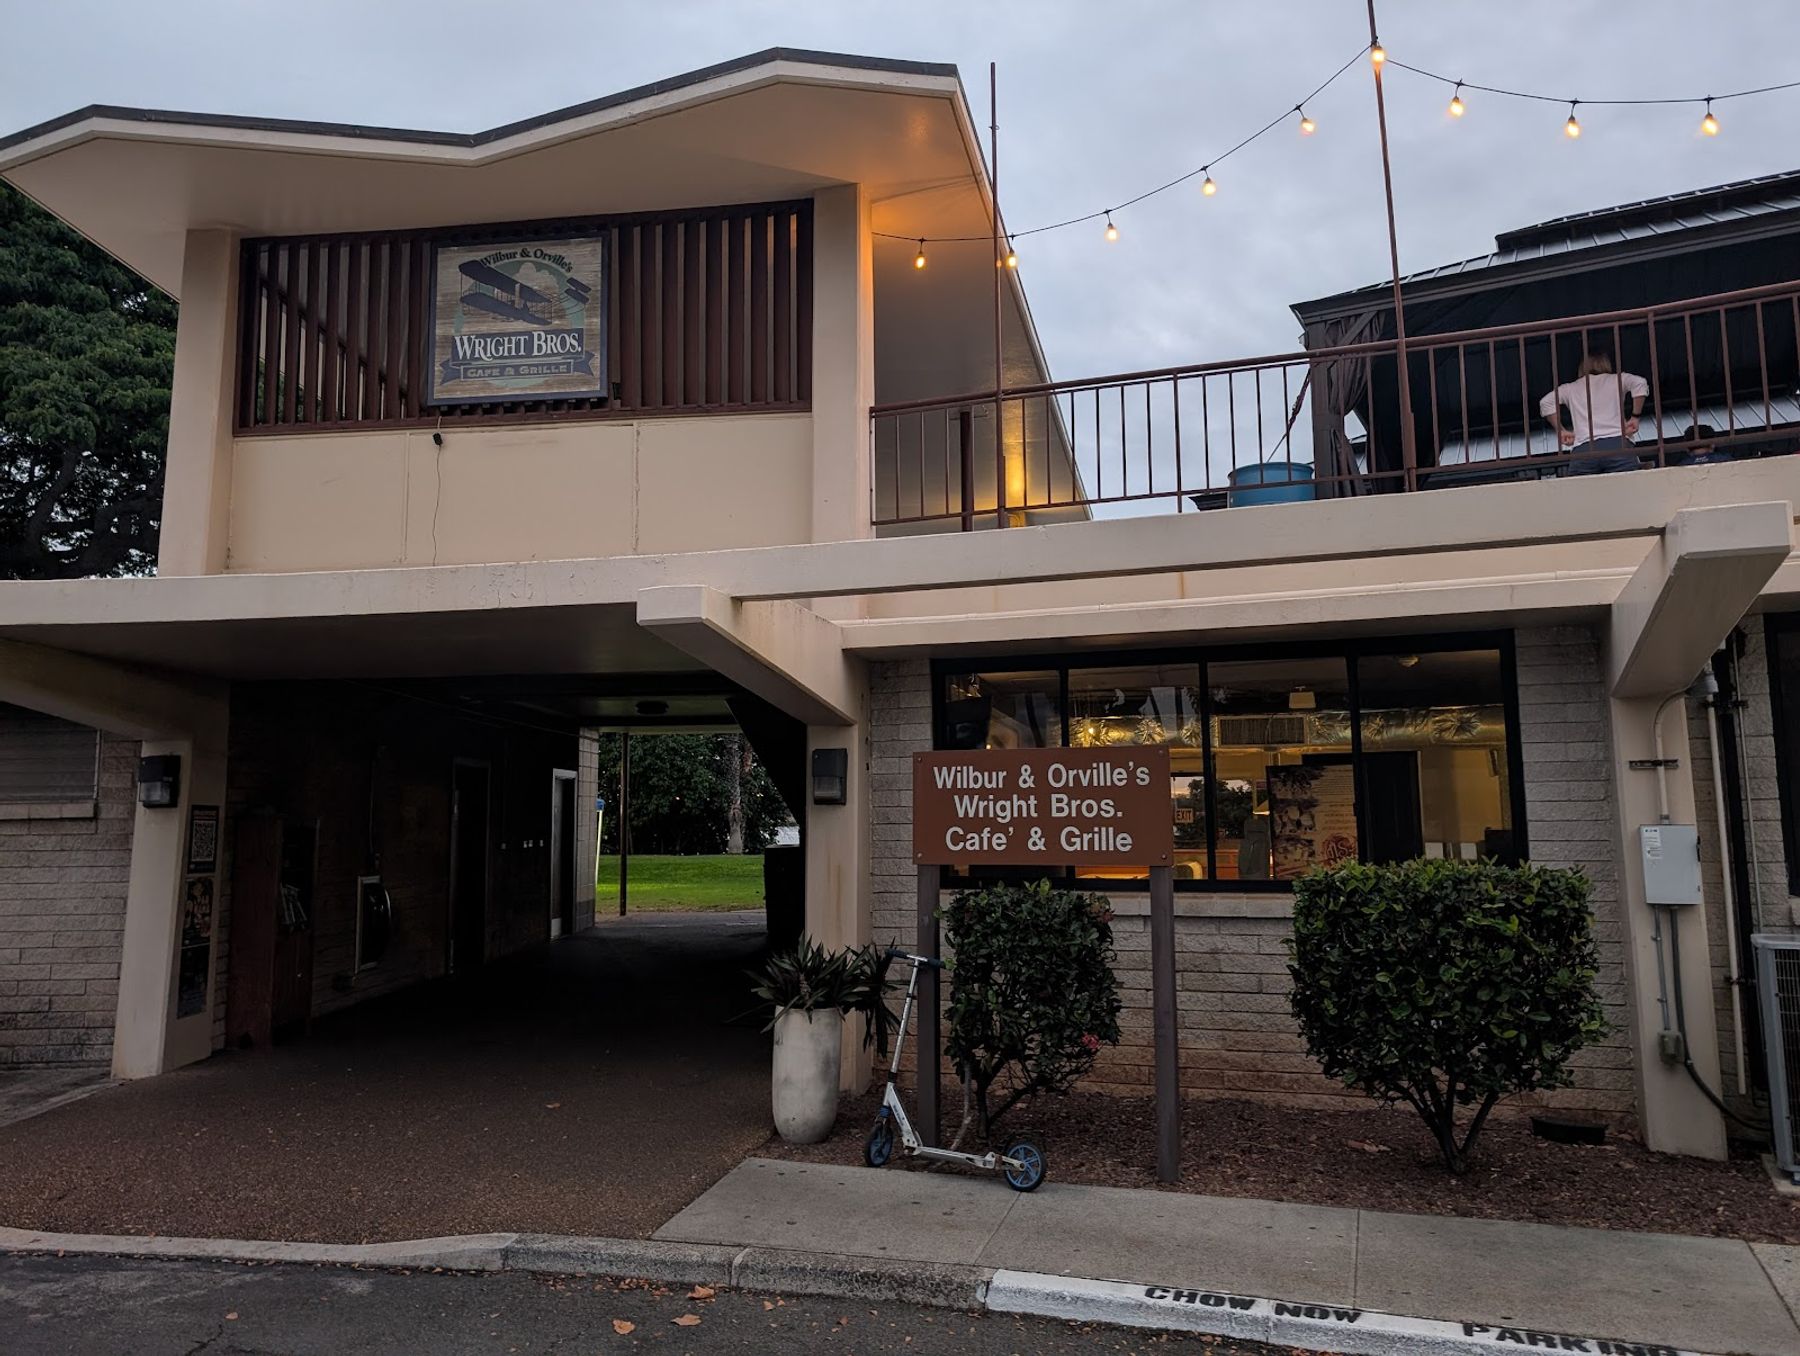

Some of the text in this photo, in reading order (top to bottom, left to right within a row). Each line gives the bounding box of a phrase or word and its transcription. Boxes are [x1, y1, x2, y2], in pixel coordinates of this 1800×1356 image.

[480, 247, 573, 273] Wilbur & Orville's
[504, 366, 515, 375] &
[519, 364, 567, 374] GRILLE
[933, 761, 1150, 789] Wilbur & Orville's
[954, 793, 1123, 823] Wright Bros.
[1175, 809, 1193, 822] EXIT
[945, 826, 1133, 852] Cafe' & Grille
[1144, 1287, 1256, 1311] CHOW
[1274, 1303, 1362, 1324] NOW
